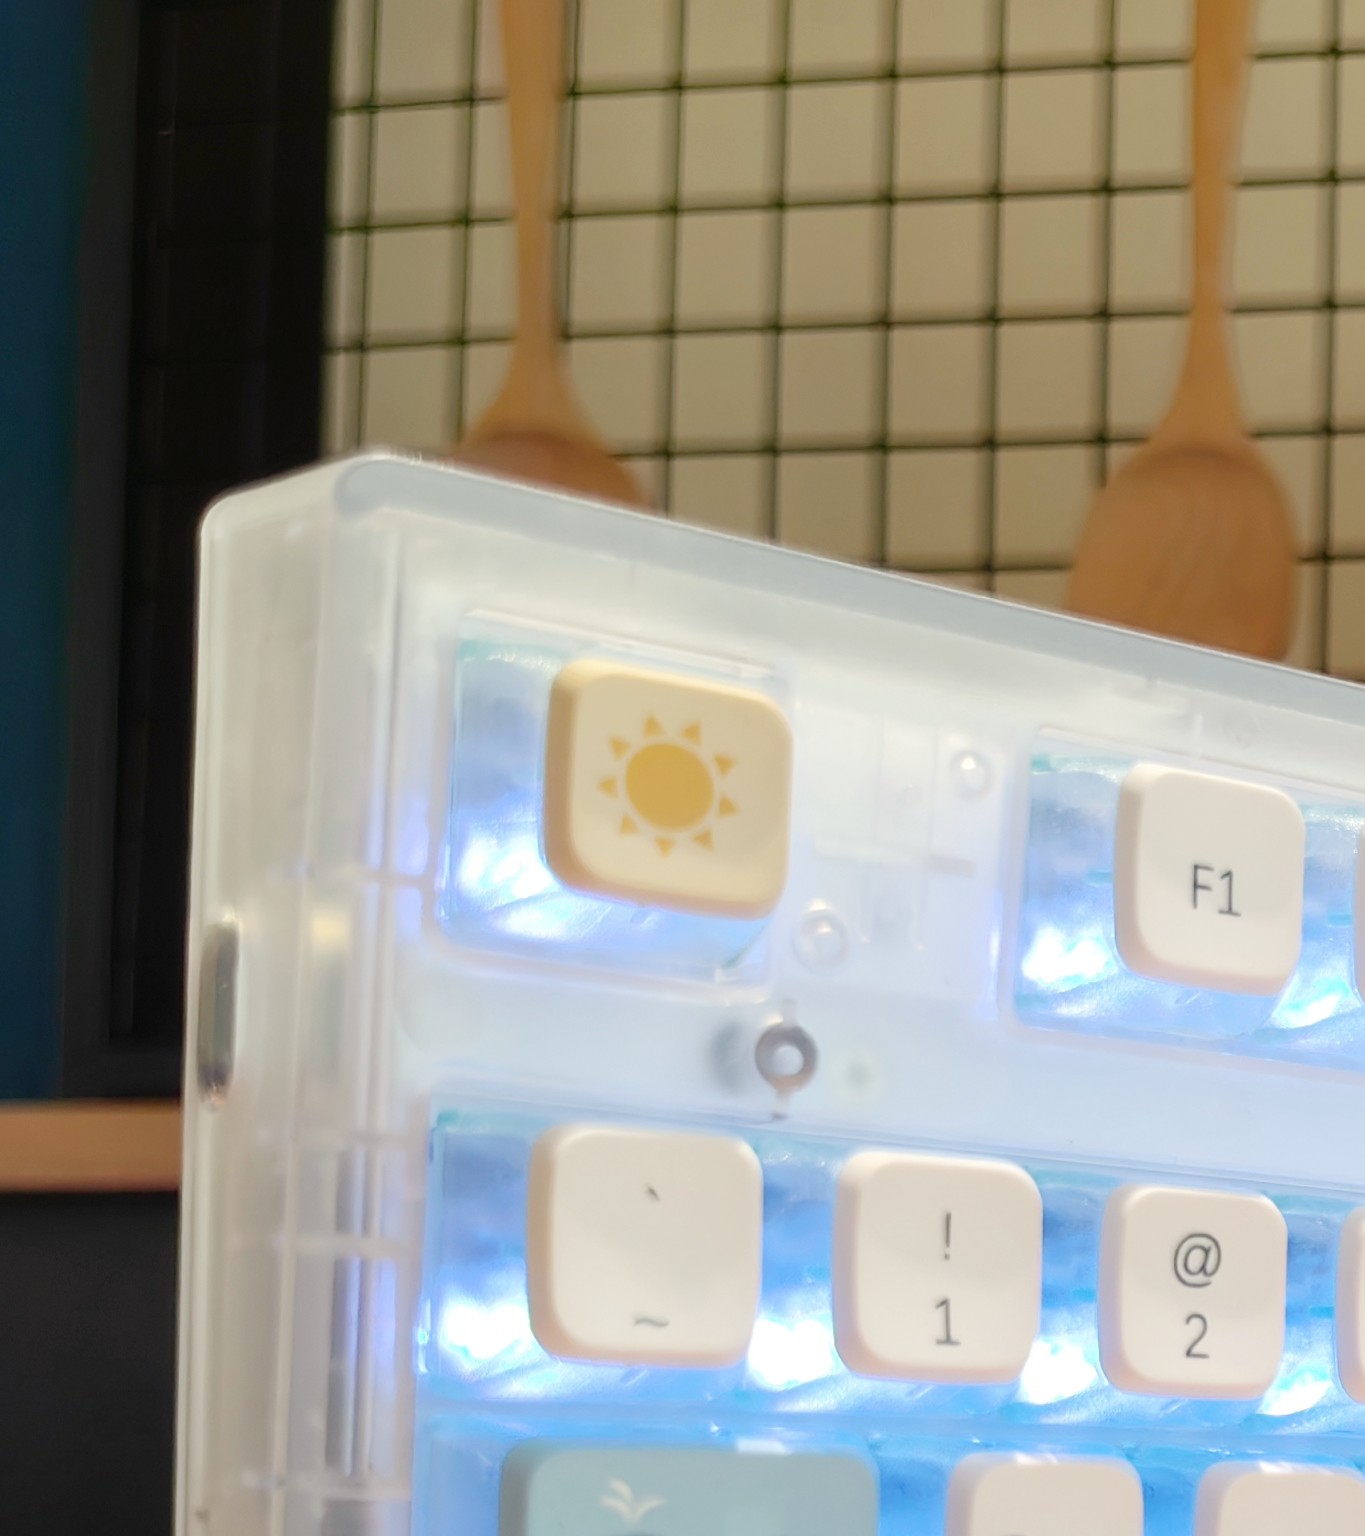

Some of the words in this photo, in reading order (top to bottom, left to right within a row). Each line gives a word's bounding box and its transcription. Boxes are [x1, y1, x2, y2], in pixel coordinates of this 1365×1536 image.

[1191, 862, 1241, 917] F1
[943, 1211, 952, 1261] !
[1172, 1231, 1222, 1289] @
[935, 1297, 960, 1347] 1
[1184, 1312, 1209, 1360] 2
